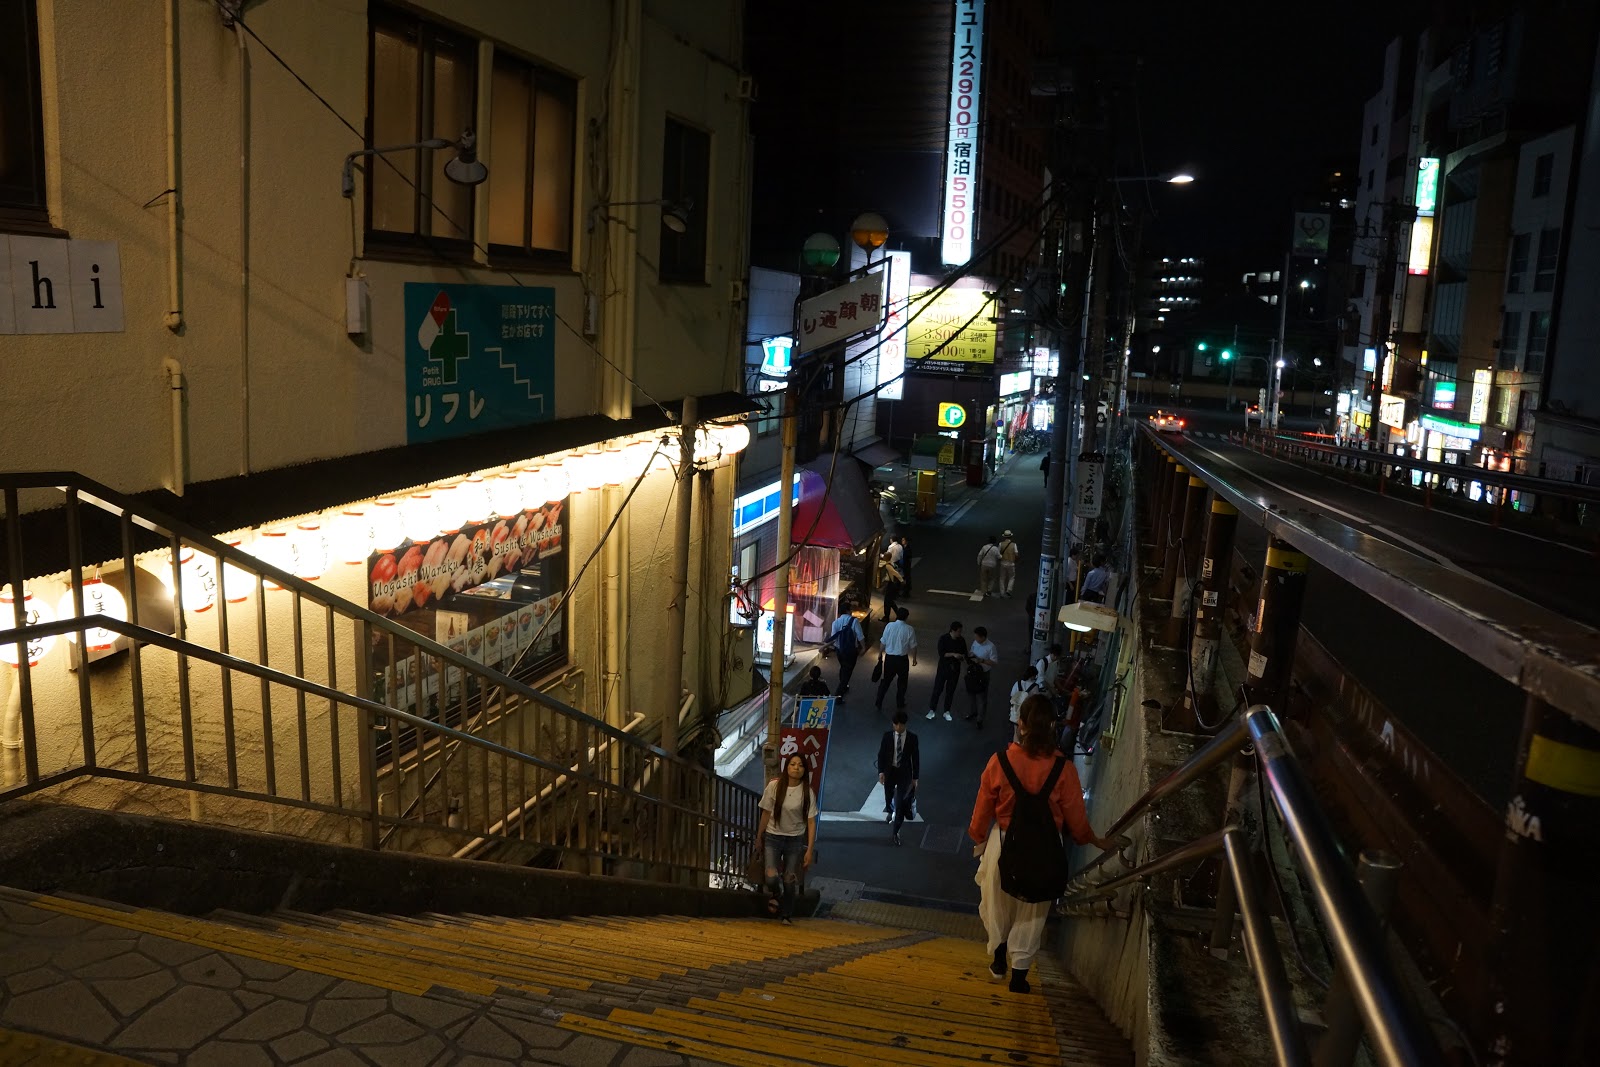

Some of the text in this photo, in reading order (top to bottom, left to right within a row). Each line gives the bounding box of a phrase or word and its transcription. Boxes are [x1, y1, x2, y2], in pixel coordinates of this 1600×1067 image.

[803, 293, 880, 335] 朝顔通り
[422, 367, 440, 376] Petit
[422, 377, 442, 387] DRUG
[415, 389, 485, 428] リフレ
[494, 537, 519, 556] Sushi
[520, 535, 527, 548] &
[530, 523, 562, 545] Washoku
[374, 574, 418, 597] Uogashi
[420, 559, 460, 583] Waraku
